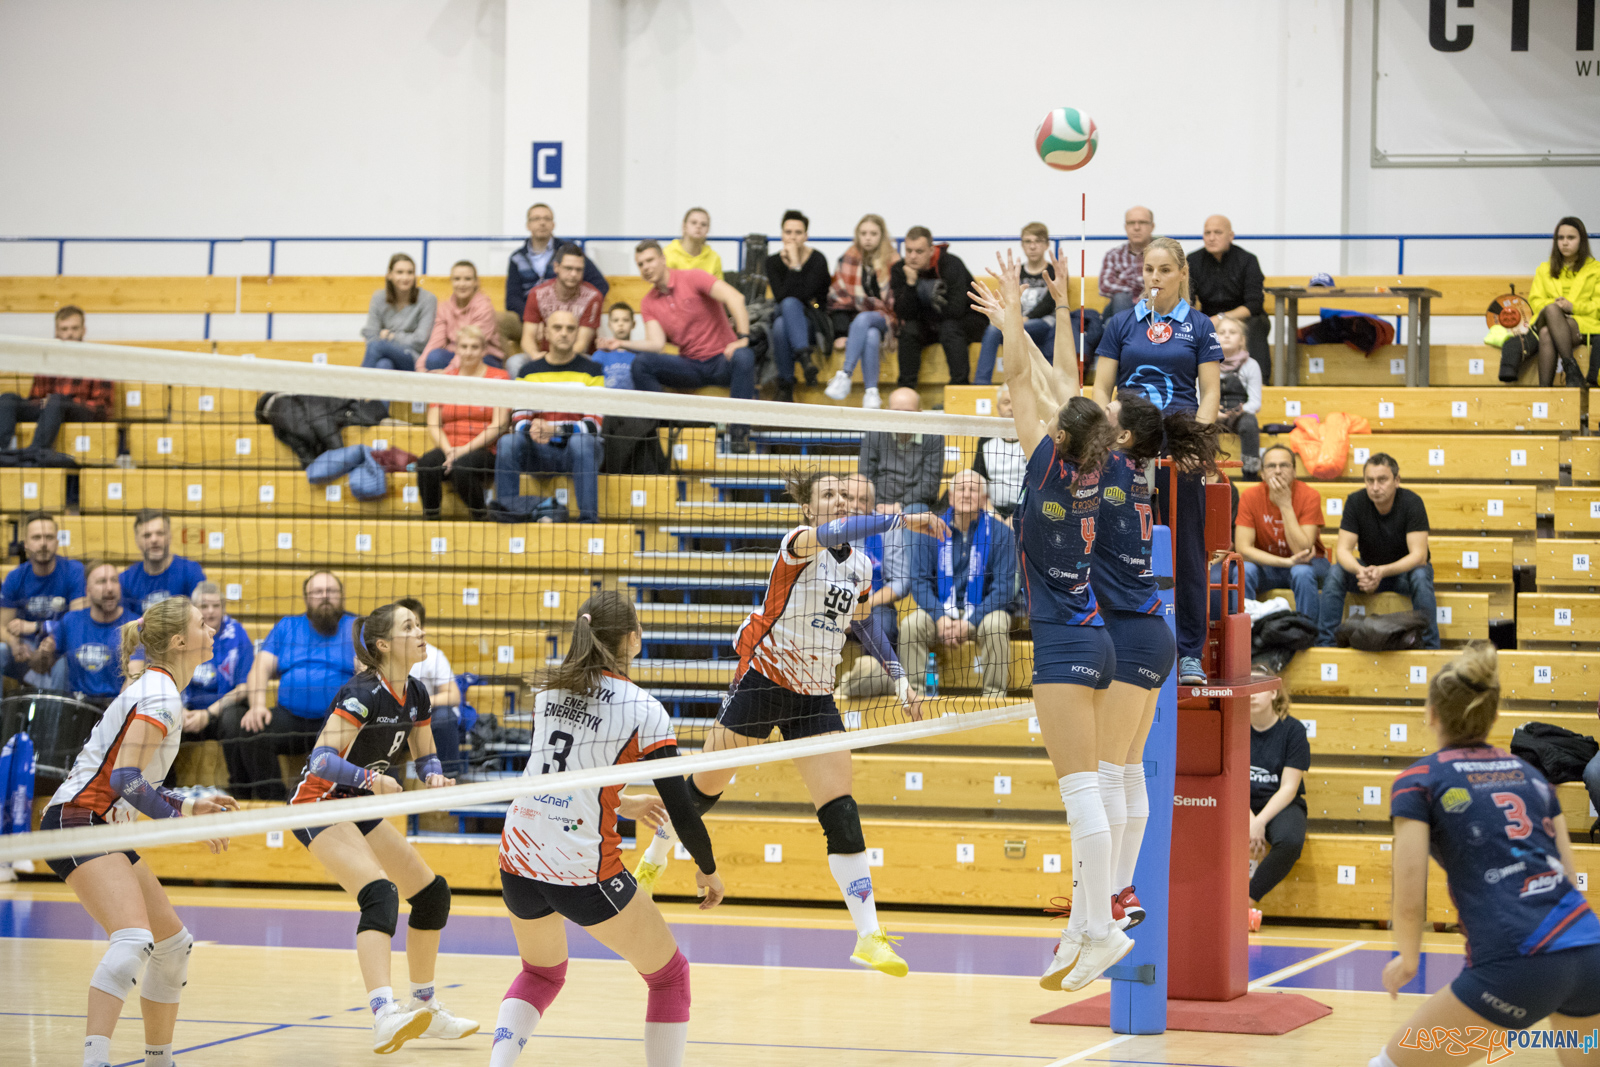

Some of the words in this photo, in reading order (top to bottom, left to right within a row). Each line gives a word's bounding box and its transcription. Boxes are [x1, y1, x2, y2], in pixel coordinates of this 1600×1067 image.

[537, 148, 556, 182] C
[1516, 452, 1521, 460] 1
[1493, 502, 1498, 510] 1
[1081, 516, 1096, 554] 4
[1576, 556, 1586, 565] 16
[824, 584, 853, 614] 99
[1441, 610, 1446, 618] 1
[1558, 611, 1568, 620] 16
[1326, 666, 1332, 675] 2
[1416, 669, 1421, 678] 1
[1538, 669, 1548, 677] 16
[1202, 688, 1232, 696] Senoh
[564, 696, 588, 712] ENEA
[544, 702, 603, 732] ENERGETYK
[1396, 727, 1401, 736] 1
[387, 731, 405, 757] 8
[542, 730, 574, 774] 3
[911, 775, 917, 784] 6
[1000, 779, 1005, 788] 5
[1370, 790, 1375, 799] 1
[1174, 795, 1217, 807] Senoh
[1491, 792, 1533, 840] 3
[770, 847, 776, 856] 7
[872, 851, 878, 860] 6
[962, 847, 968, 856] 5
[1049, 857, 1055, 866] 4
[1344, 869, 1349, 878] 1
